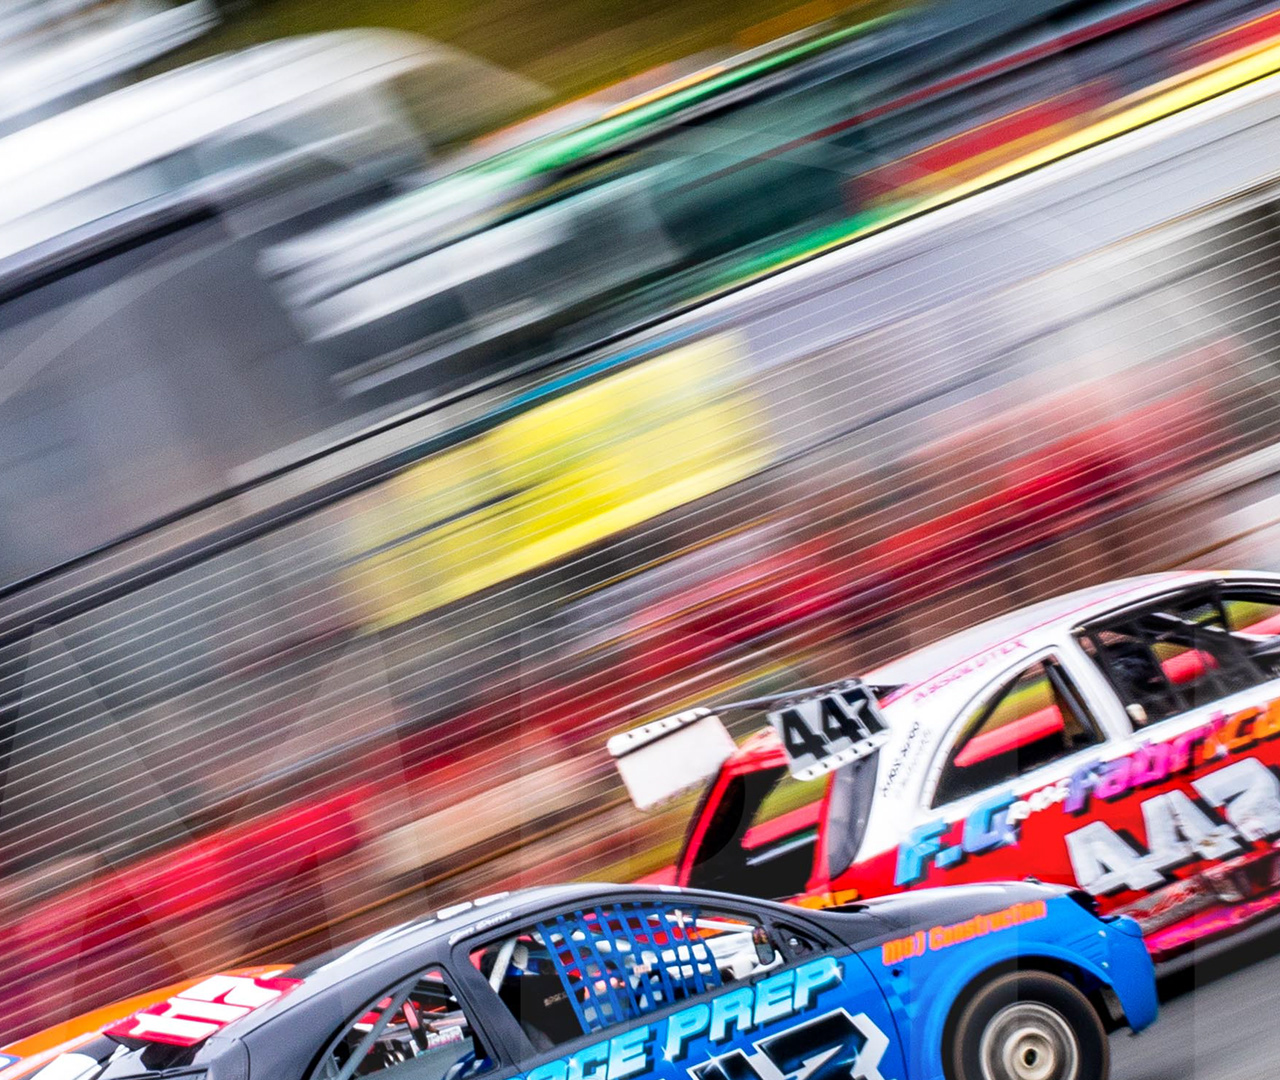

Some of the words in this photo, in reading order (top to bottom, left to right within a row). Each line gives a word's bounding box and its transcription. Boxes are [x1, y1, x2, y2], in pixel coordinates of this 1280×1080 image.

[779, 686, 886, 763] 447
[128, 975, 286, 1040] 117
[662, 956, 846, 1062] PREP
